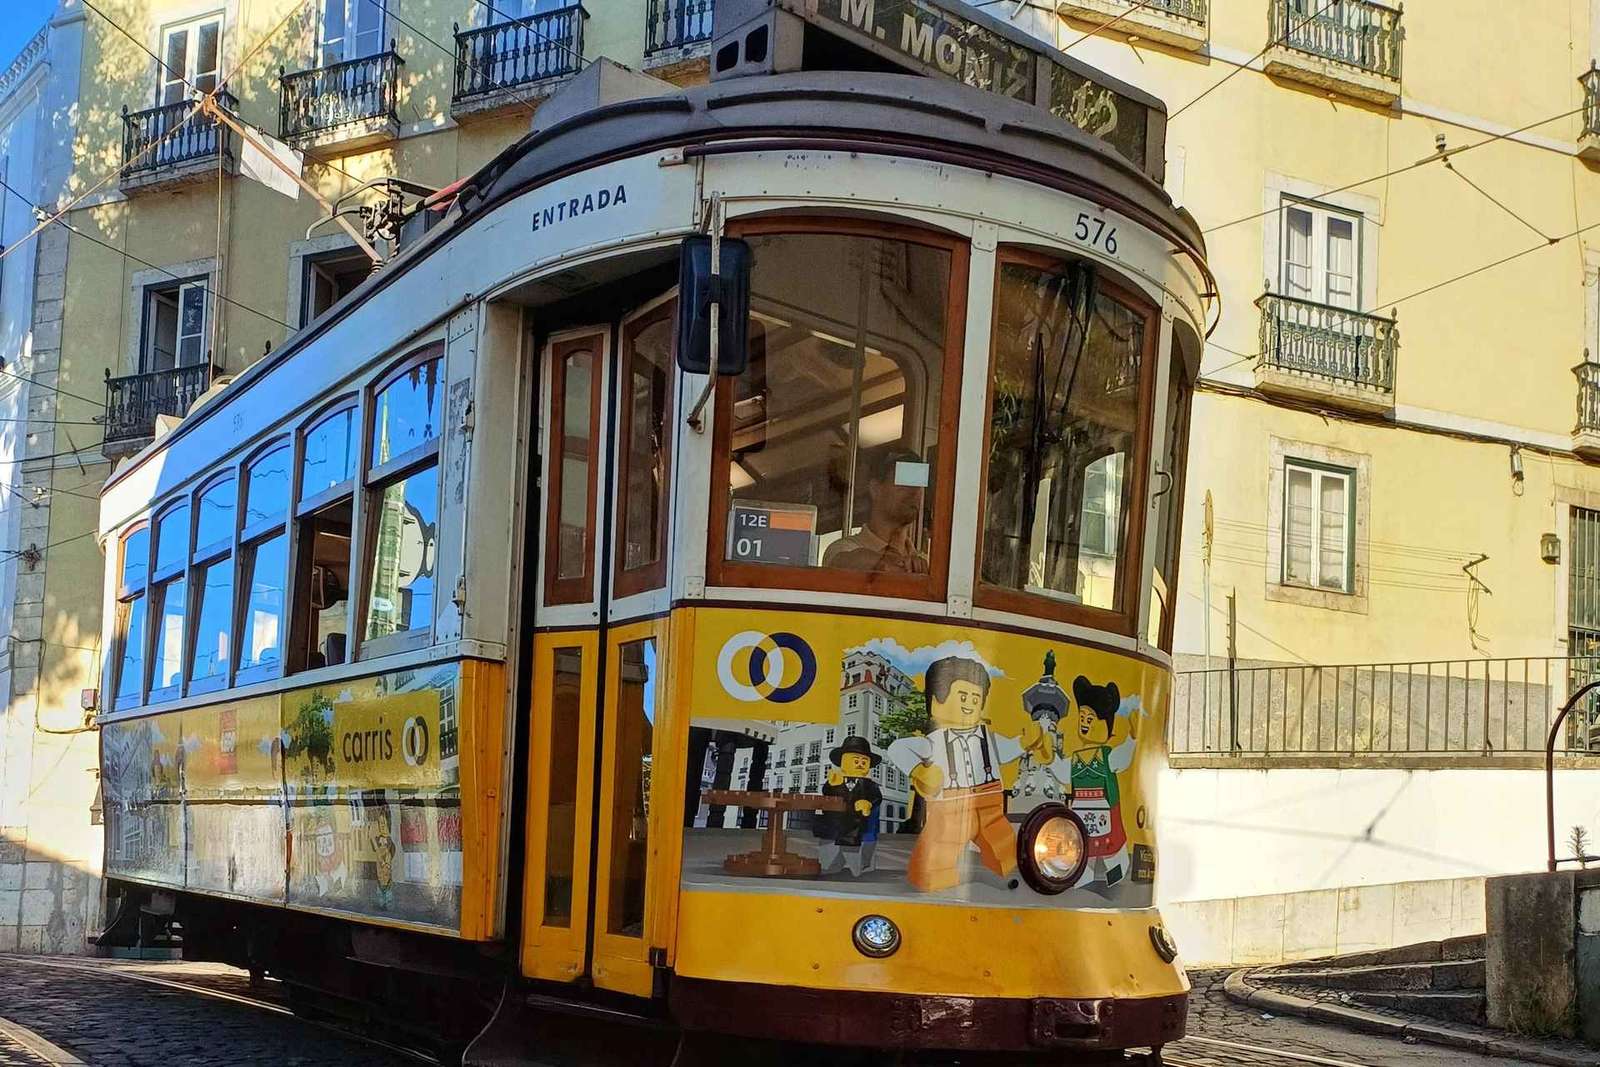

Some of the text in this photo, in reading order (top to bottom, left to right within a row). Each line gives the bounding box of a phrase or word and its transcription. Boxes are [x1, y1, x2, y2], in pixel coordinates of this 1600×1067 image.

[532, 184, 627, 232] ENTRADA
[1075, 212, 1117, 254] 576
[740, 514, 767, 527] 12E
[736, 538, 762, 557] 01
[343, 716, 393, 763] carris
